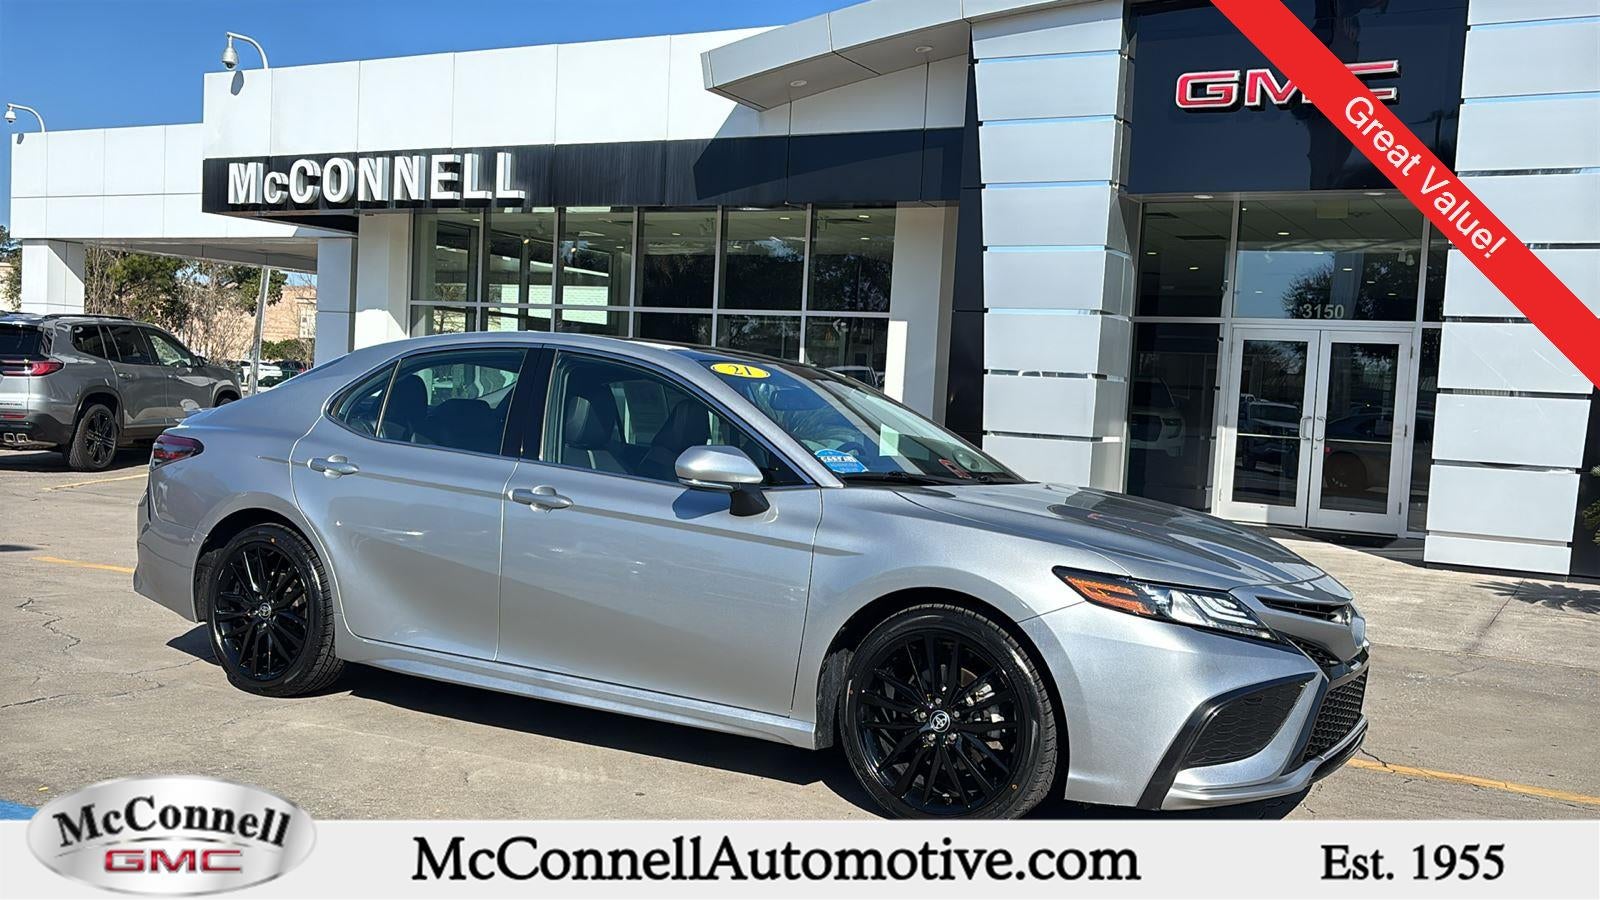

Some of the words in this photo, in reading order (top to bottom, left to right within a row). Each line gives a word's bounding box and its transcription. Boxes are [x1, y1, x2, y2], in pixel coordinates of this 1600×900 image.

[227, 151, 526, 206] McCONNELL
[1302, 303, 1345, 319] 3150
[728, 364, 752, 376] 21
